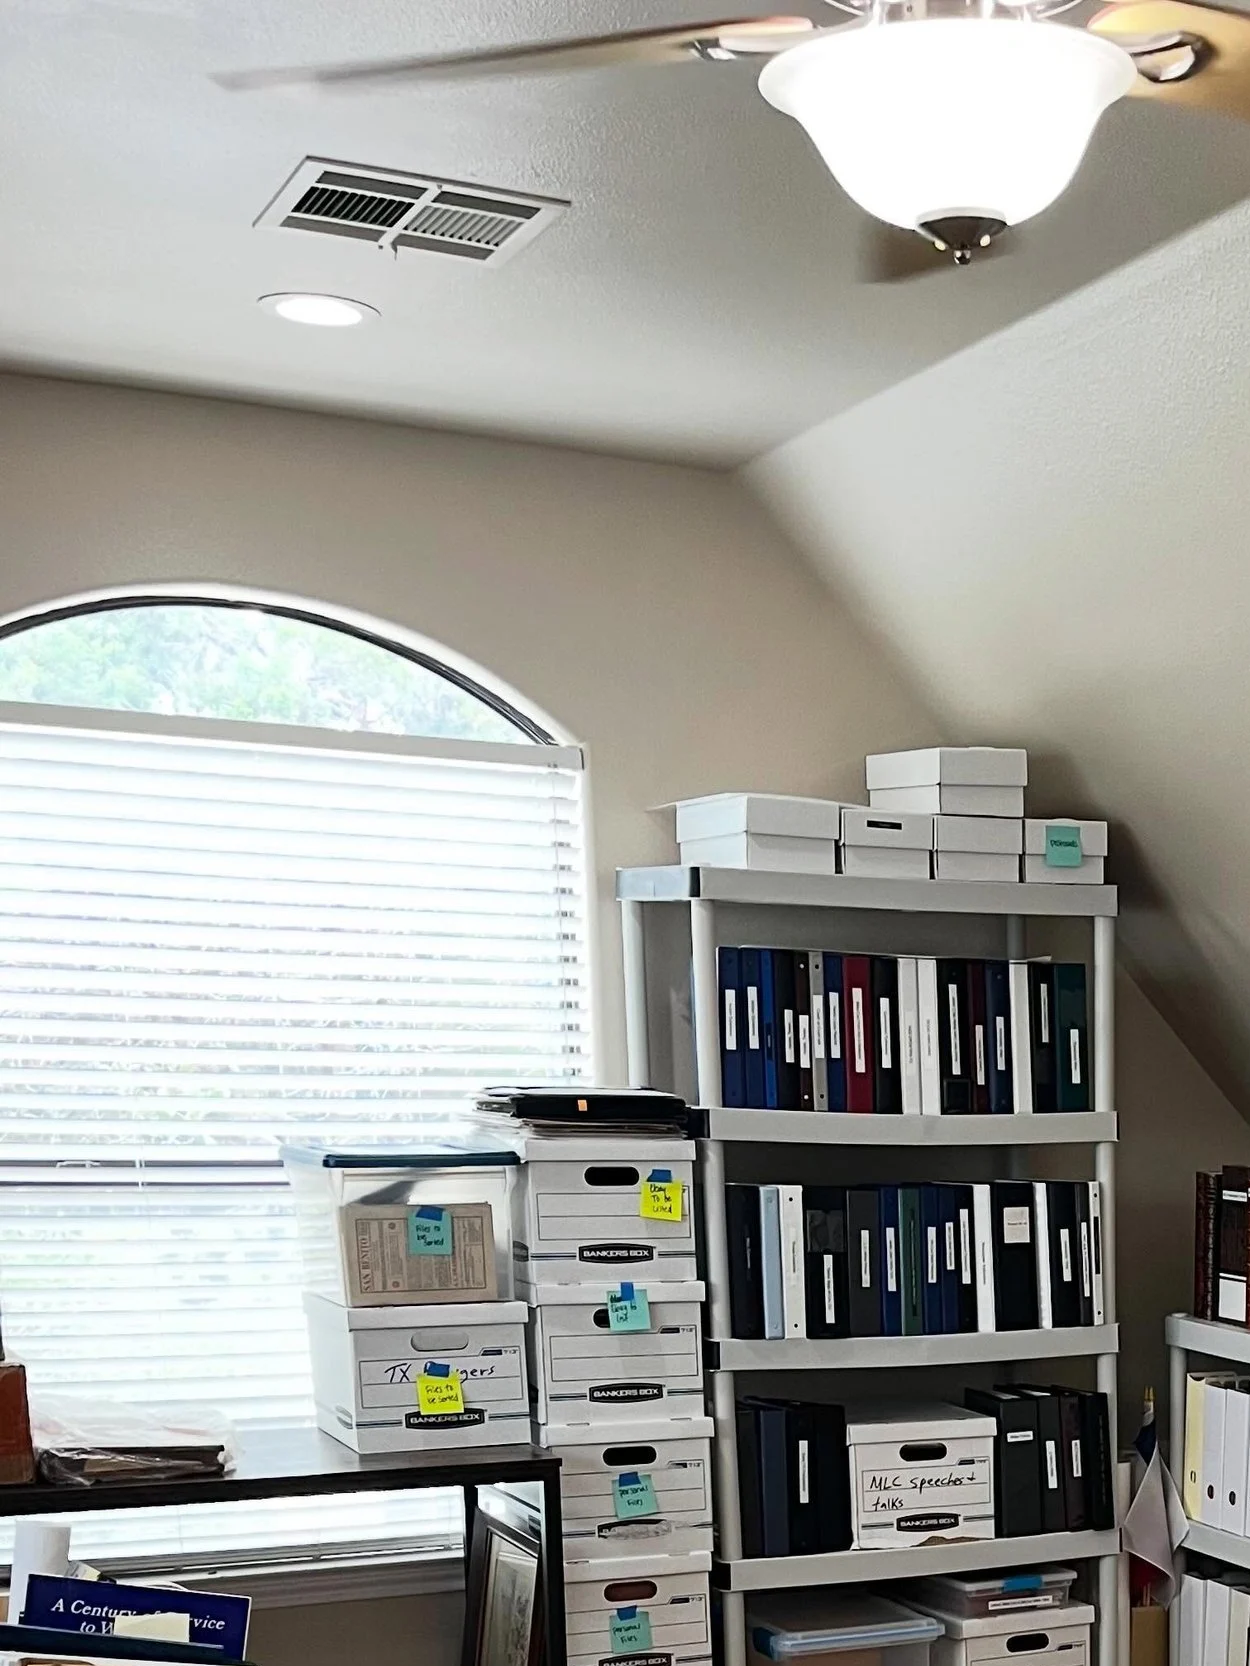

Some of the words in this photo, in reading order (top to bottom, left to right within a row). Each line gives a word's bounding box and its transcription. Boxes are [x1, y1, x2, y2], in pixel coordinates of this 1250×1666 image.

[629, 1249, 650, 1257] BOX
[384, 1362, 412, 1383] TX
[593, 1389, 638, 1398] BANKERS
[639, 1388, 660, 1396] BOX
[410, 1415, 459, 1425] BANKERS
[460, 1412, 481, 1421] BOX
[869, 1475, 903, 1491] MLC
[900, 1518, 938, 1528] BANKERS
[938, 1517, 956, 1525] BOX
[51, 1598, 65, 1613] A
[80, 1621, 97, 1634] to
[648, 1657, 668, 1665] BOX
